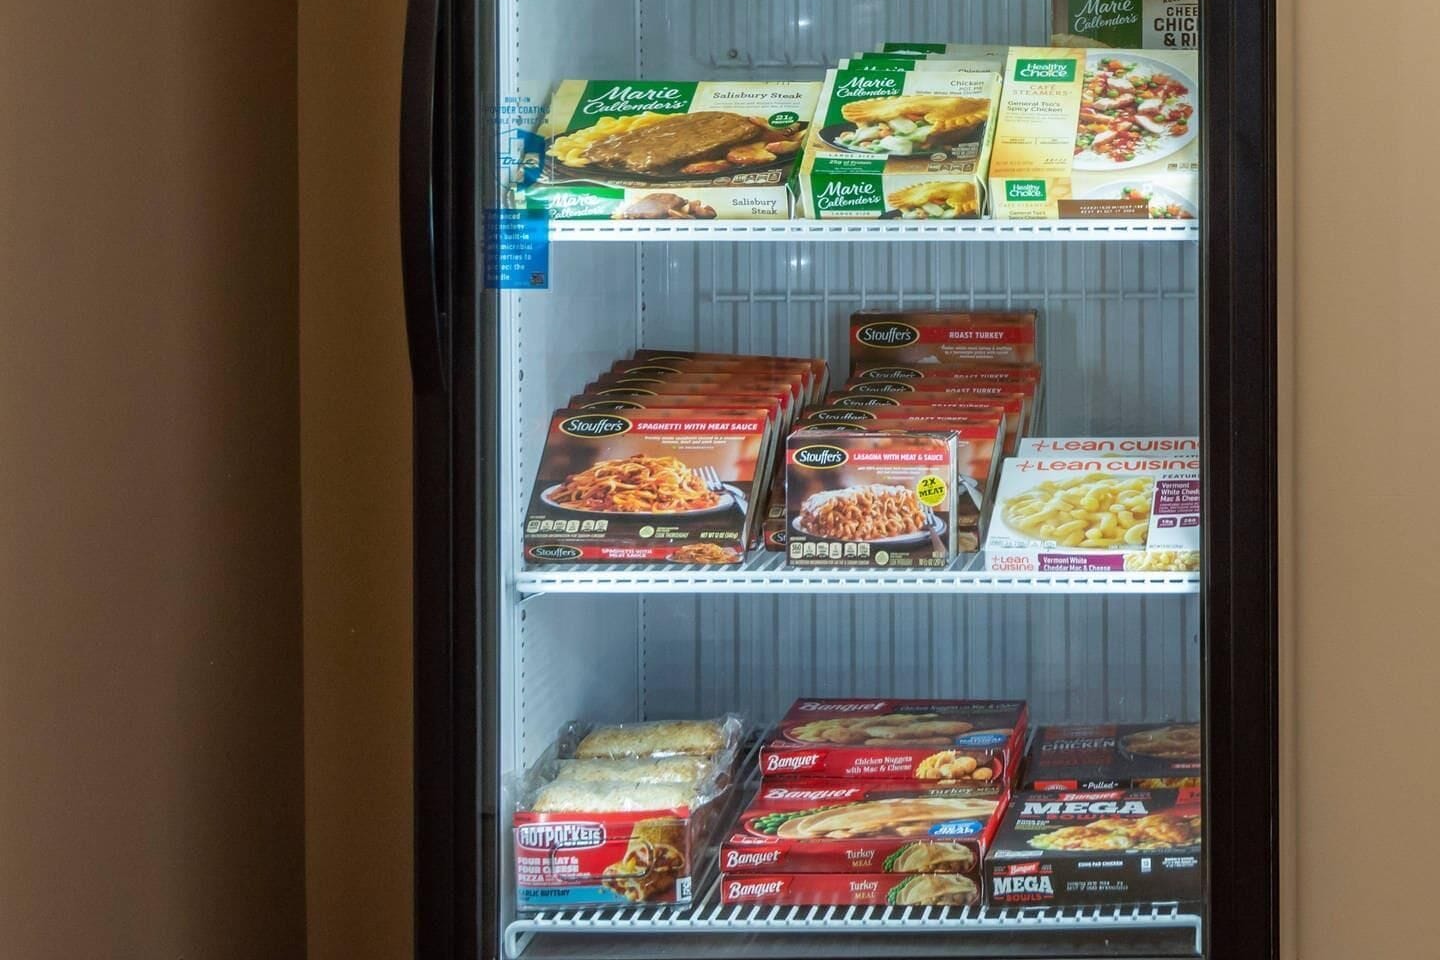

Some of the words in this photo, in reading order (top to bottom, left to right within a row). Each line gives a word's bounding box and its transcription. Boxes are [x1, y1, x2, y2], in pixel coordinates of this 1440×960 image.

[1166, 6, 1198, 17] CHEE
[1074, 13, 1138, 33] Callender's
[1154, 17, 1195, 32] CHIC
[1164, 32, 1176, 47] &
[1181, 32, 1196, 47] RI
[1026, 62, 1068, 72] Healthy
[1020, 69, 1068, 78] Choice
[838, 76, 896, 90] Marie
[588, 86, 683, 103] Marie
[713, 91, 768, 101] Salisbury
[770, 92, 803, 100] Steak
[836, 87, 900, 98] Callender's
[582, 99, 689, 115] Callender's
[1008, 100, 1039, 108] General
[1007, 106, 1028, 114] Spicy
[817, 181, 875, 198] Marie
[1009, 189, 1041, 197] Choice
[1012, 184, 1040, 192] Healthy
[550, 193, 600, 208] Marie
[732, 197, 776, 208] Salisbury
[817, 194, 882, 210] Callender's
[751, 207, 778, 216] Steak
[863, 329, 913, 343] Stouffer's
[949, 331, 974, 340] ROAST
[975, 331, 1004, 340] TURKEY
[568, 419, 624, 434] Stouffer's
[637, 422, 682, 431] SPAGHETTI
[683, 422, 706, 431] WITH
[708, 422, 730, 431] MEAT
[731, 422, 758, 431] SAUCE
[1052, 440, 1114, 451] Lean
[799, 450, 843, 464] Stouffer's
[883, 453, 900, 461] WITH
[901, 453, 917, 461] MEAT
[924, 453, 944, 461] SAUCE
[1037, 460, 1101, 471] Lean
[921, 477, 936, 487] 2X
[919, 486, 945, 498] MEAT
[1161, 488, 1181, 496] White
[535, 547, 577, 558] Stouffer's
[992, 563, 1034, 571] cuisine
[1042, 740, 1116, 752] CHICKEN
[767, 754, 818, 771] Banquet
[854, 757, 883, 766] Chicken
[884, 756, 912, 767] Nuggets
[863, 766, 879, 774] Mac
[764, 789, 862, 800] Banquet
[930, 788, 972, 796] Turkey
[1021, 801, 1149, 815] MEGA
[727, 849, 781, 867] Banquet
[846, 849, 875, 860] Turkey
[852, 857, 873, 867] MEAL
[729, 881, 784, 898] Banquet
[849, 881, 878, 892] Turkey
[992, 875, 1054, 895] MEGA
[855, 891, 875, 899] MEAL
[1006, 893, 1042, 902] BOWLS
